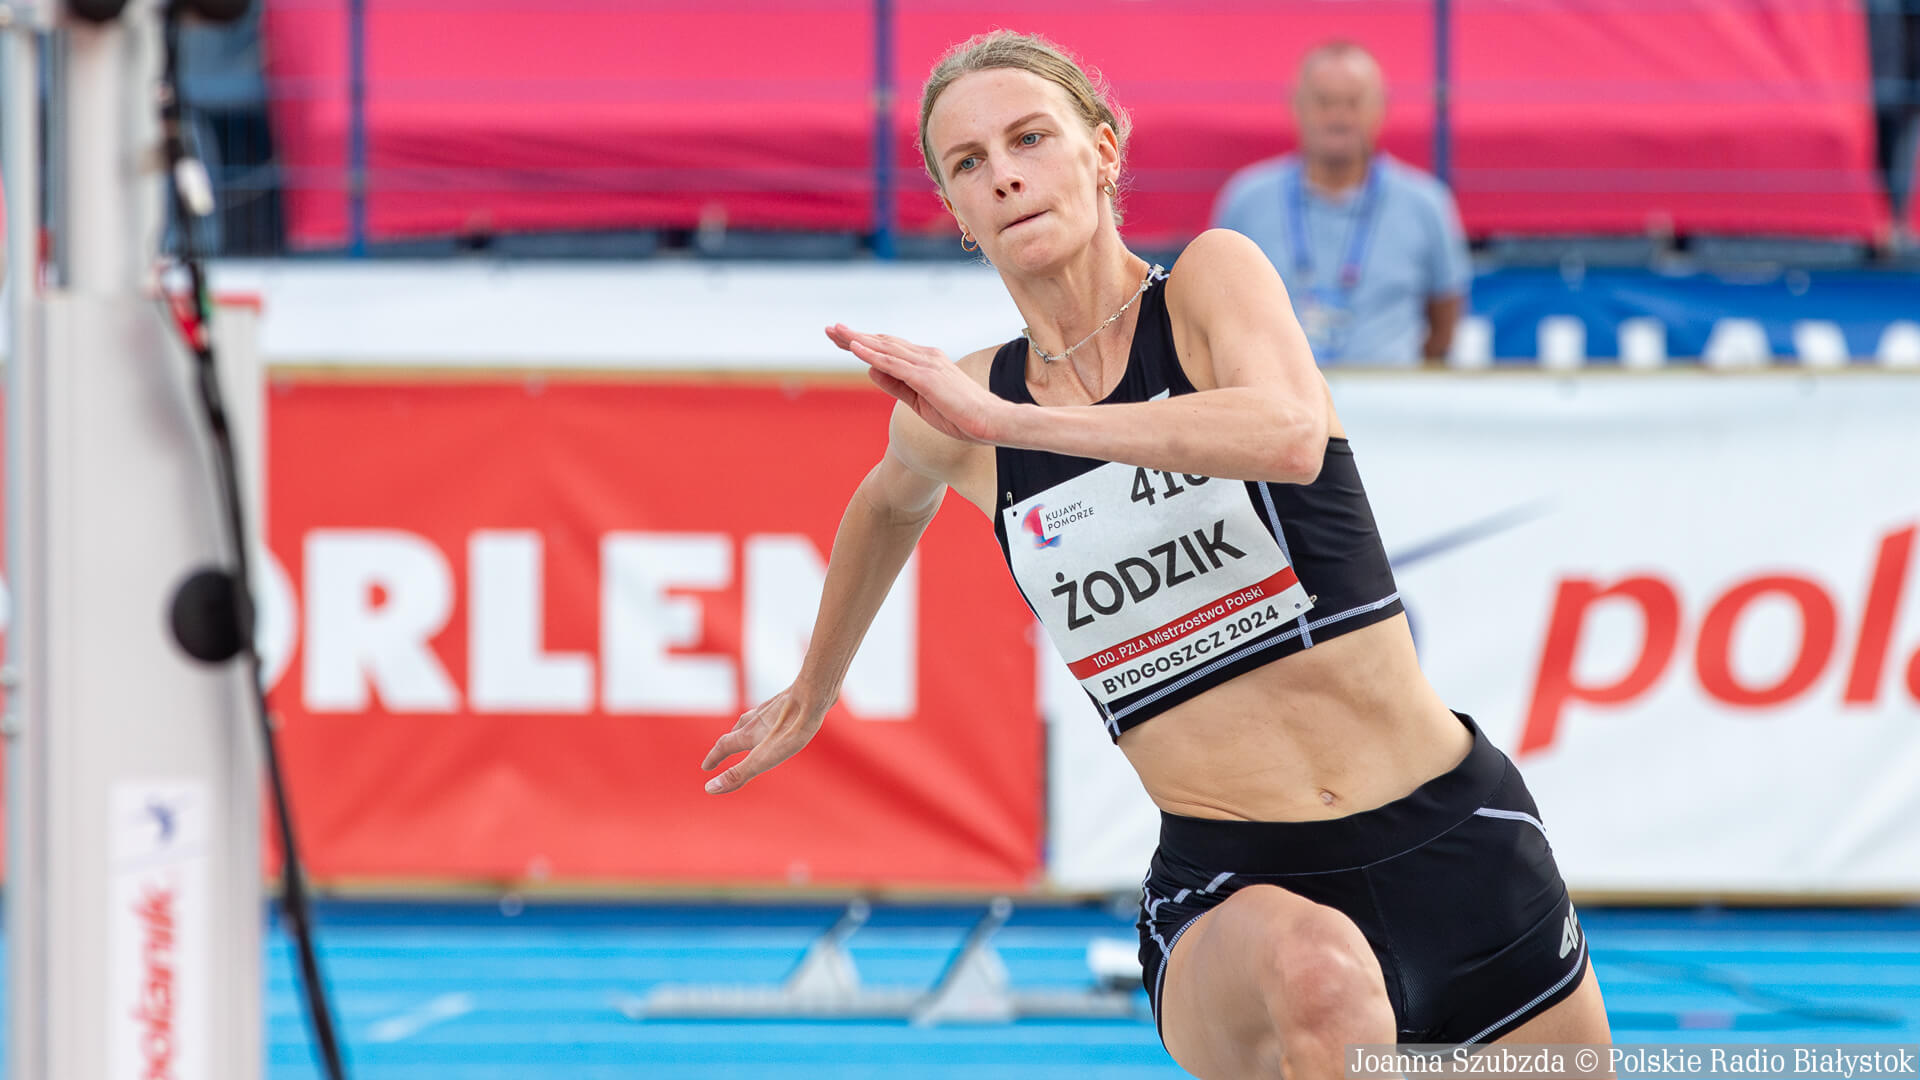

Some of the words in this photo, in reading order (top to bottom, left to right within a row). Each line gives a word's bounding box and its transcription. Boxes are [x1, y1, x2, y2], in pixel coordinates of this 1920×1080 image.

[1045, 500, 1082, 522] KUJAWY
[1047, 506, 1094, 532] POMORZE
[1050, 519, 1247, 631] ŻODZIK
[1092, 650, 1120, 669] 100.
[1119, 639, 1149, 659] PZLA
[1147, 602, 1226, 647] Mistrzostwa
[1225, 585, 1265, 611] Polski
[1102, 630, 1225, 695] BYDGOSZCZ
[1225, 604, 1280, 641] 2024
[1516, 520, 1920, 760] pol
